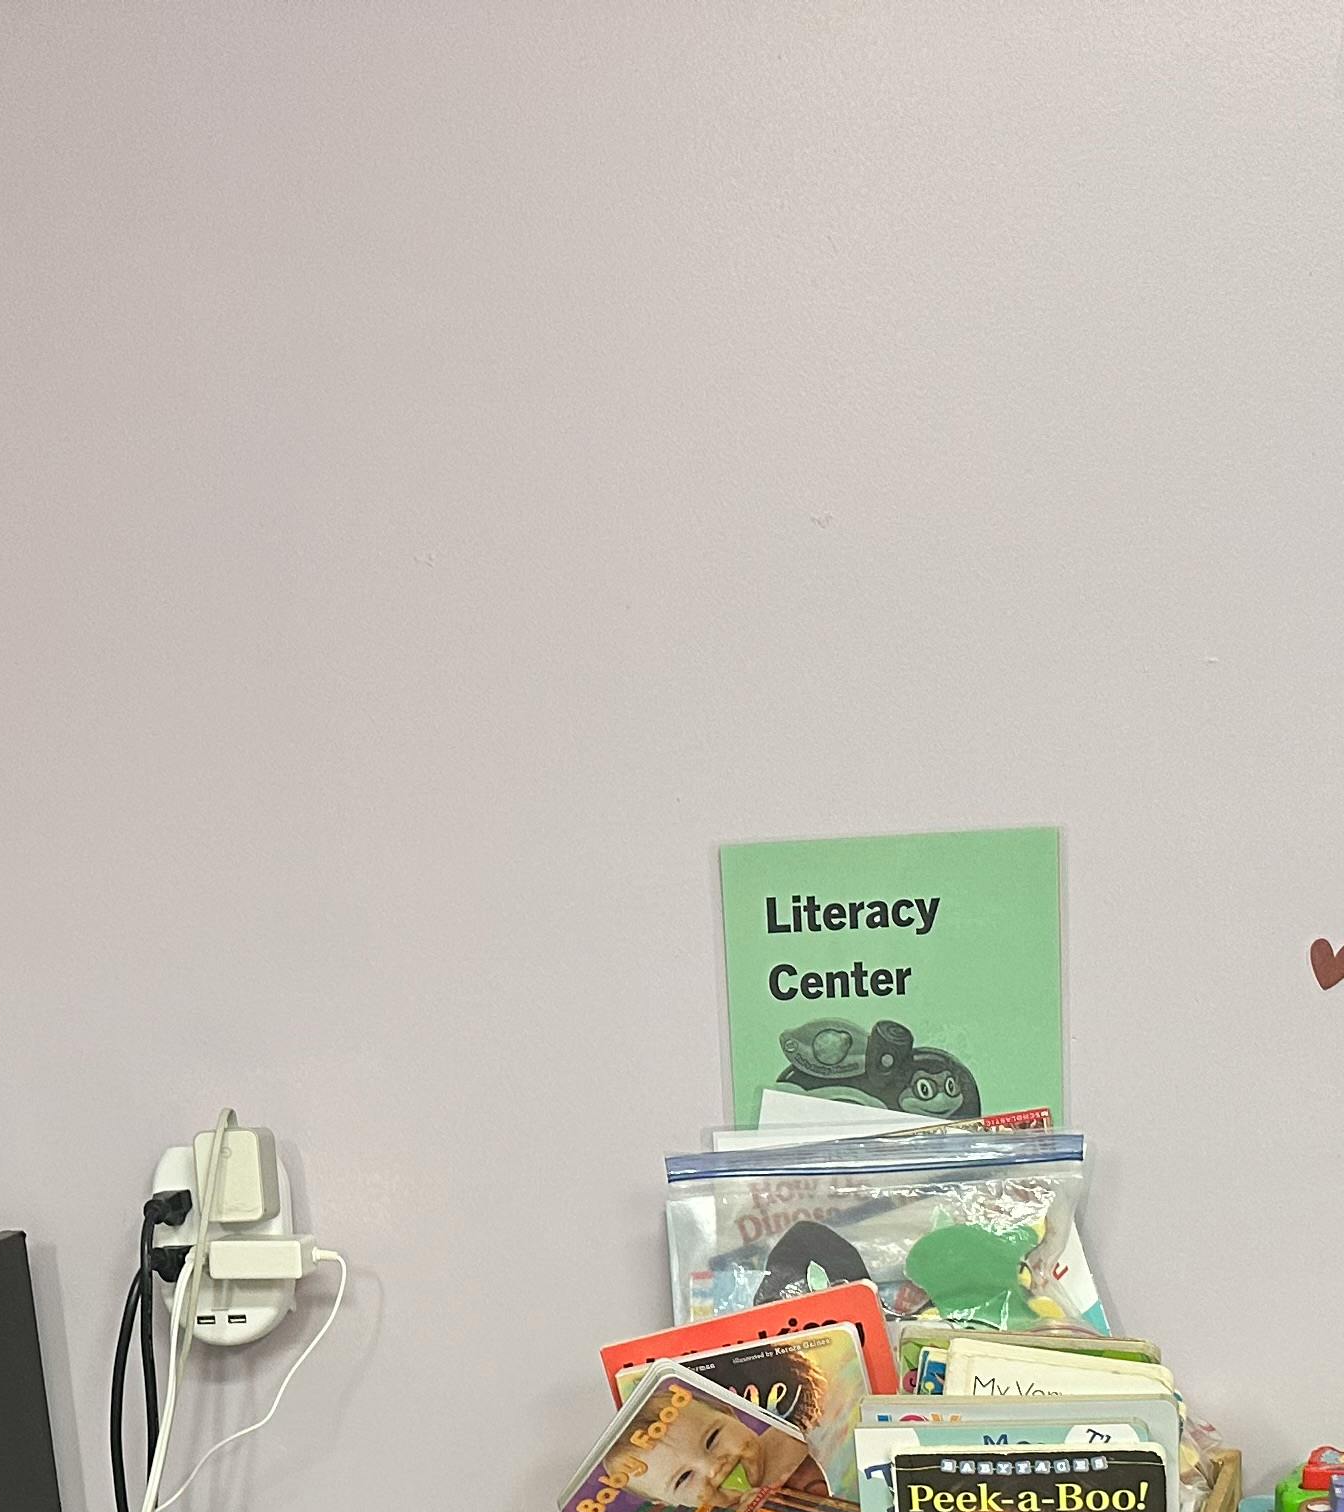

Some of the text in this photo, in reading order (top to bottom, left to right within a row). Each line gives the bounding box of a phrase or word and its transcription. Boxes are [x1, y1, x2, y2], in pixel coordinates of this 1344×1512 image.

[765, 894, 941, 936] Literacy
[768, 961, 912, 1001] Center
[630, 1384, 693, 1449] Food
